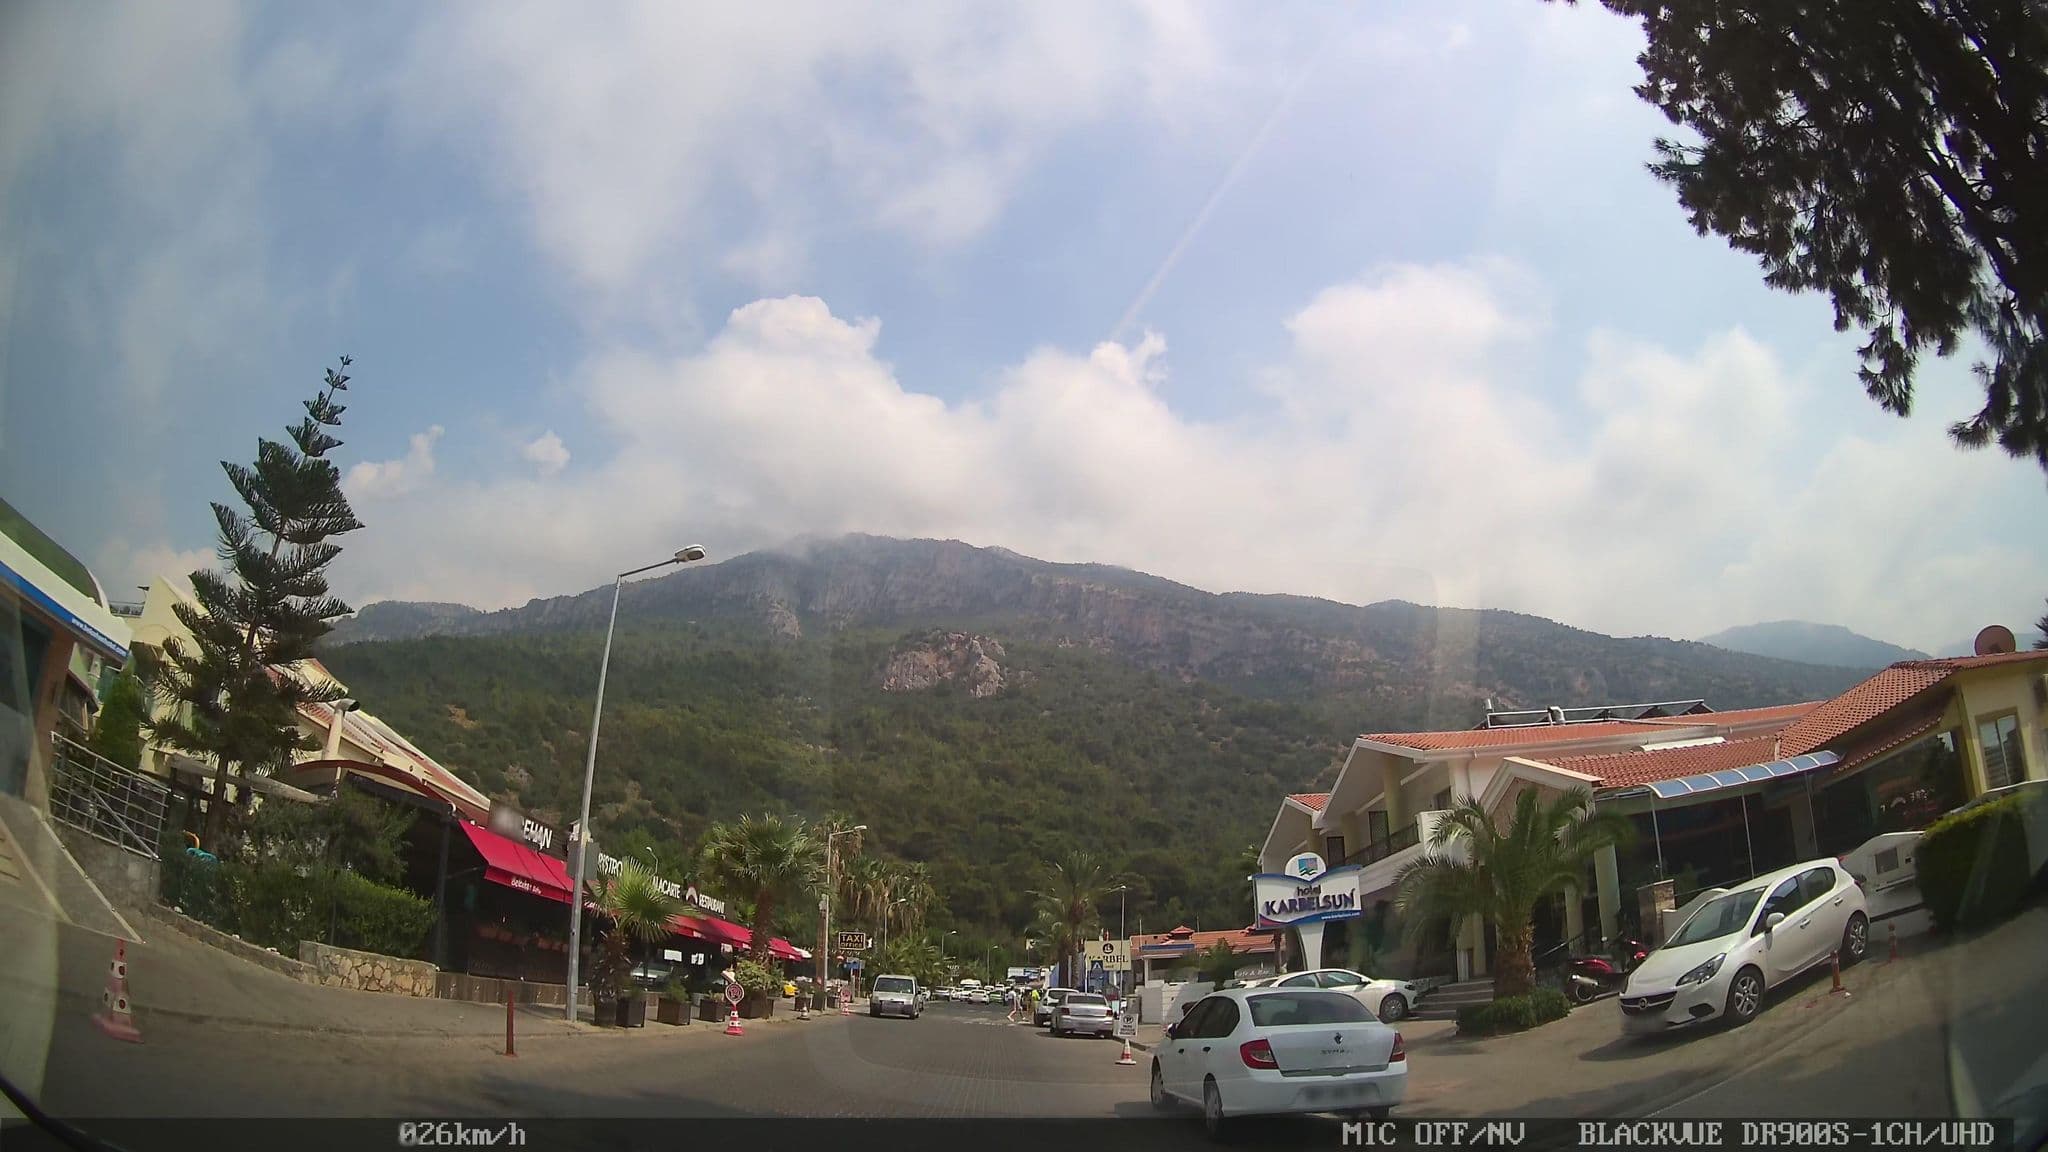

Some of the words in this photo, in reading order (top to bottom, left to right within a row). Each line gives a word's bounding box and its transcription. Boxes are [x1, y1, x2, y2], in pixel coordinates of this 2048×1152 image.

[598, 853, 623, 877] BISTRO
[1297, 885, 1322, 897] hotel
[1264, 888, 1356, 915] KARBELSUN
[841, 934, 863, 943] TAXI
